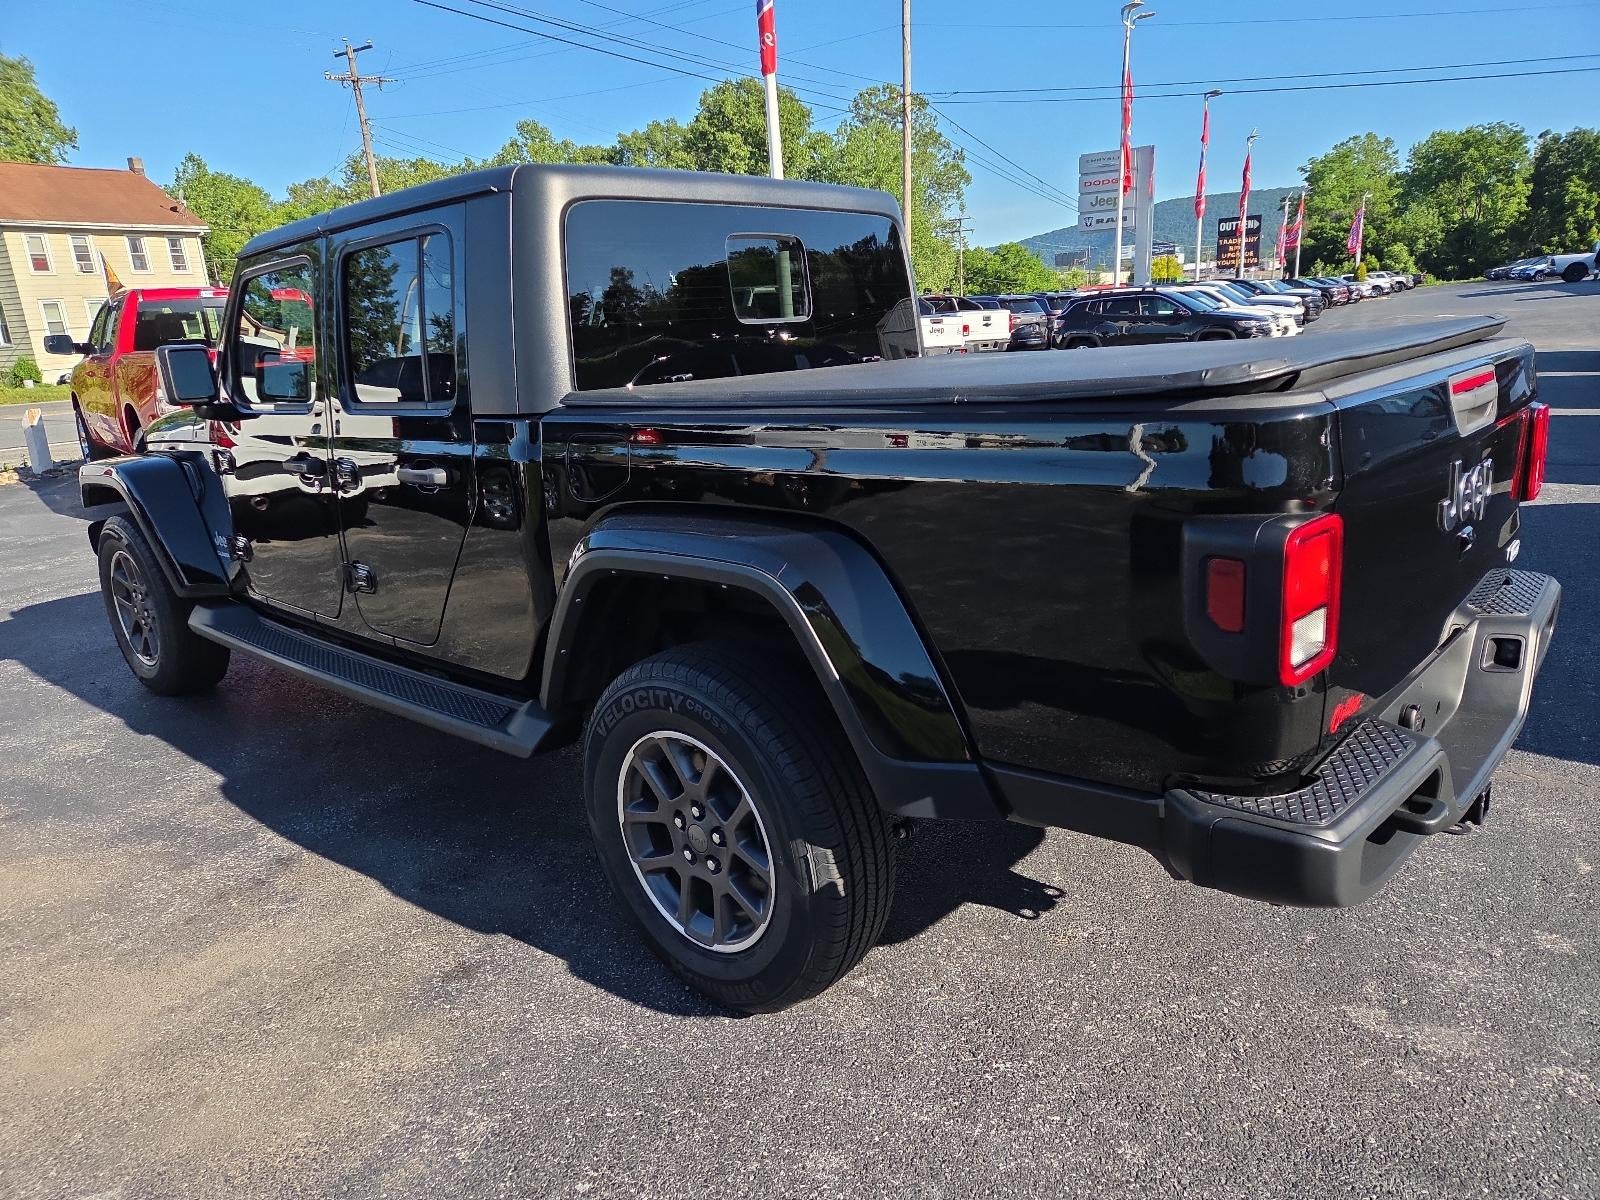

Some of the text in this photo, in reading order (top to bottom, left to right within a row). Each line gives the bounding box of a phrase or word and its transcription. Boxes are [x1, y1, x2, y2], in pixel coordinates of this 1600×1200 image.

[1084, 177, 1120, 187] DODG
[929, 326, 945, 334] Jeep
[595, 689, 729, 737] VELOCITY CROSS
